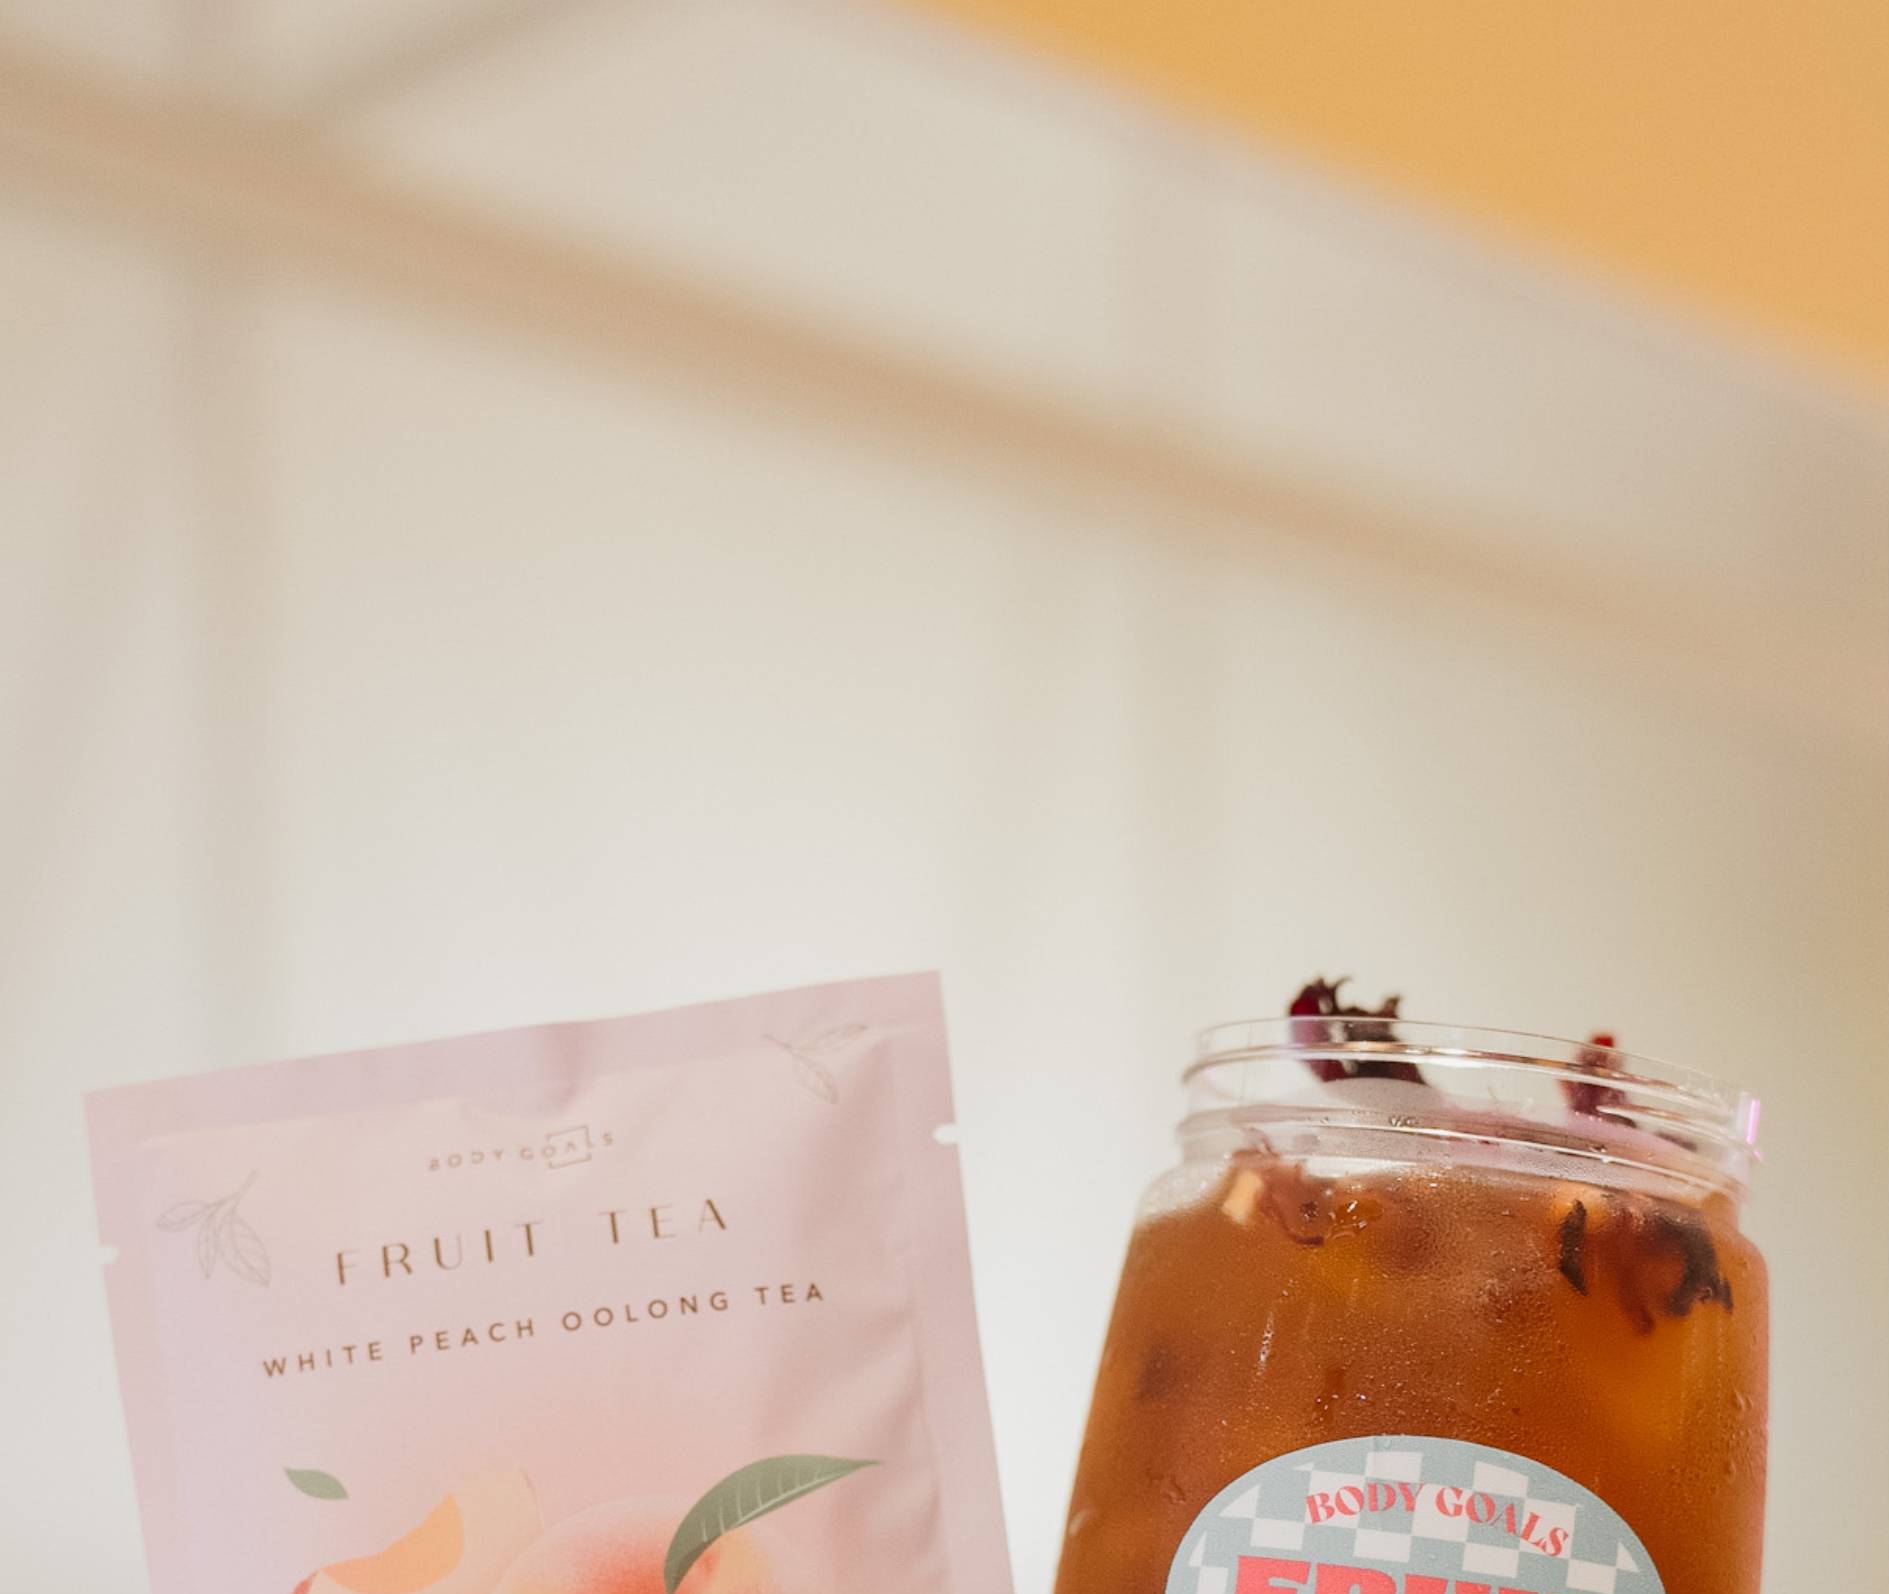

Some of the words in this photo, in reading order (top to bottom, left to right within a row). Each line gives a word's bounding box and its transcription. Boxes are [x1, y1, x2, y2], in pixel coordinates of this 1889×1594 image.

[428, 1149, 503, 1172] BODY
[334, 1221, 547, 1287] FRUIT
[596, 1197, 732, 1246] TEA
[262, 1342, 384, 1379] WHITE
[408, 1318, 538, 1356] PEACH
[561, 1290, 731, 1334] OOLONG
[754, 1281, 827, 1308] TEA
[1305, 1482, 1425, 1525] BODY
[1435, 1486, 1570, 1557] GOALS
